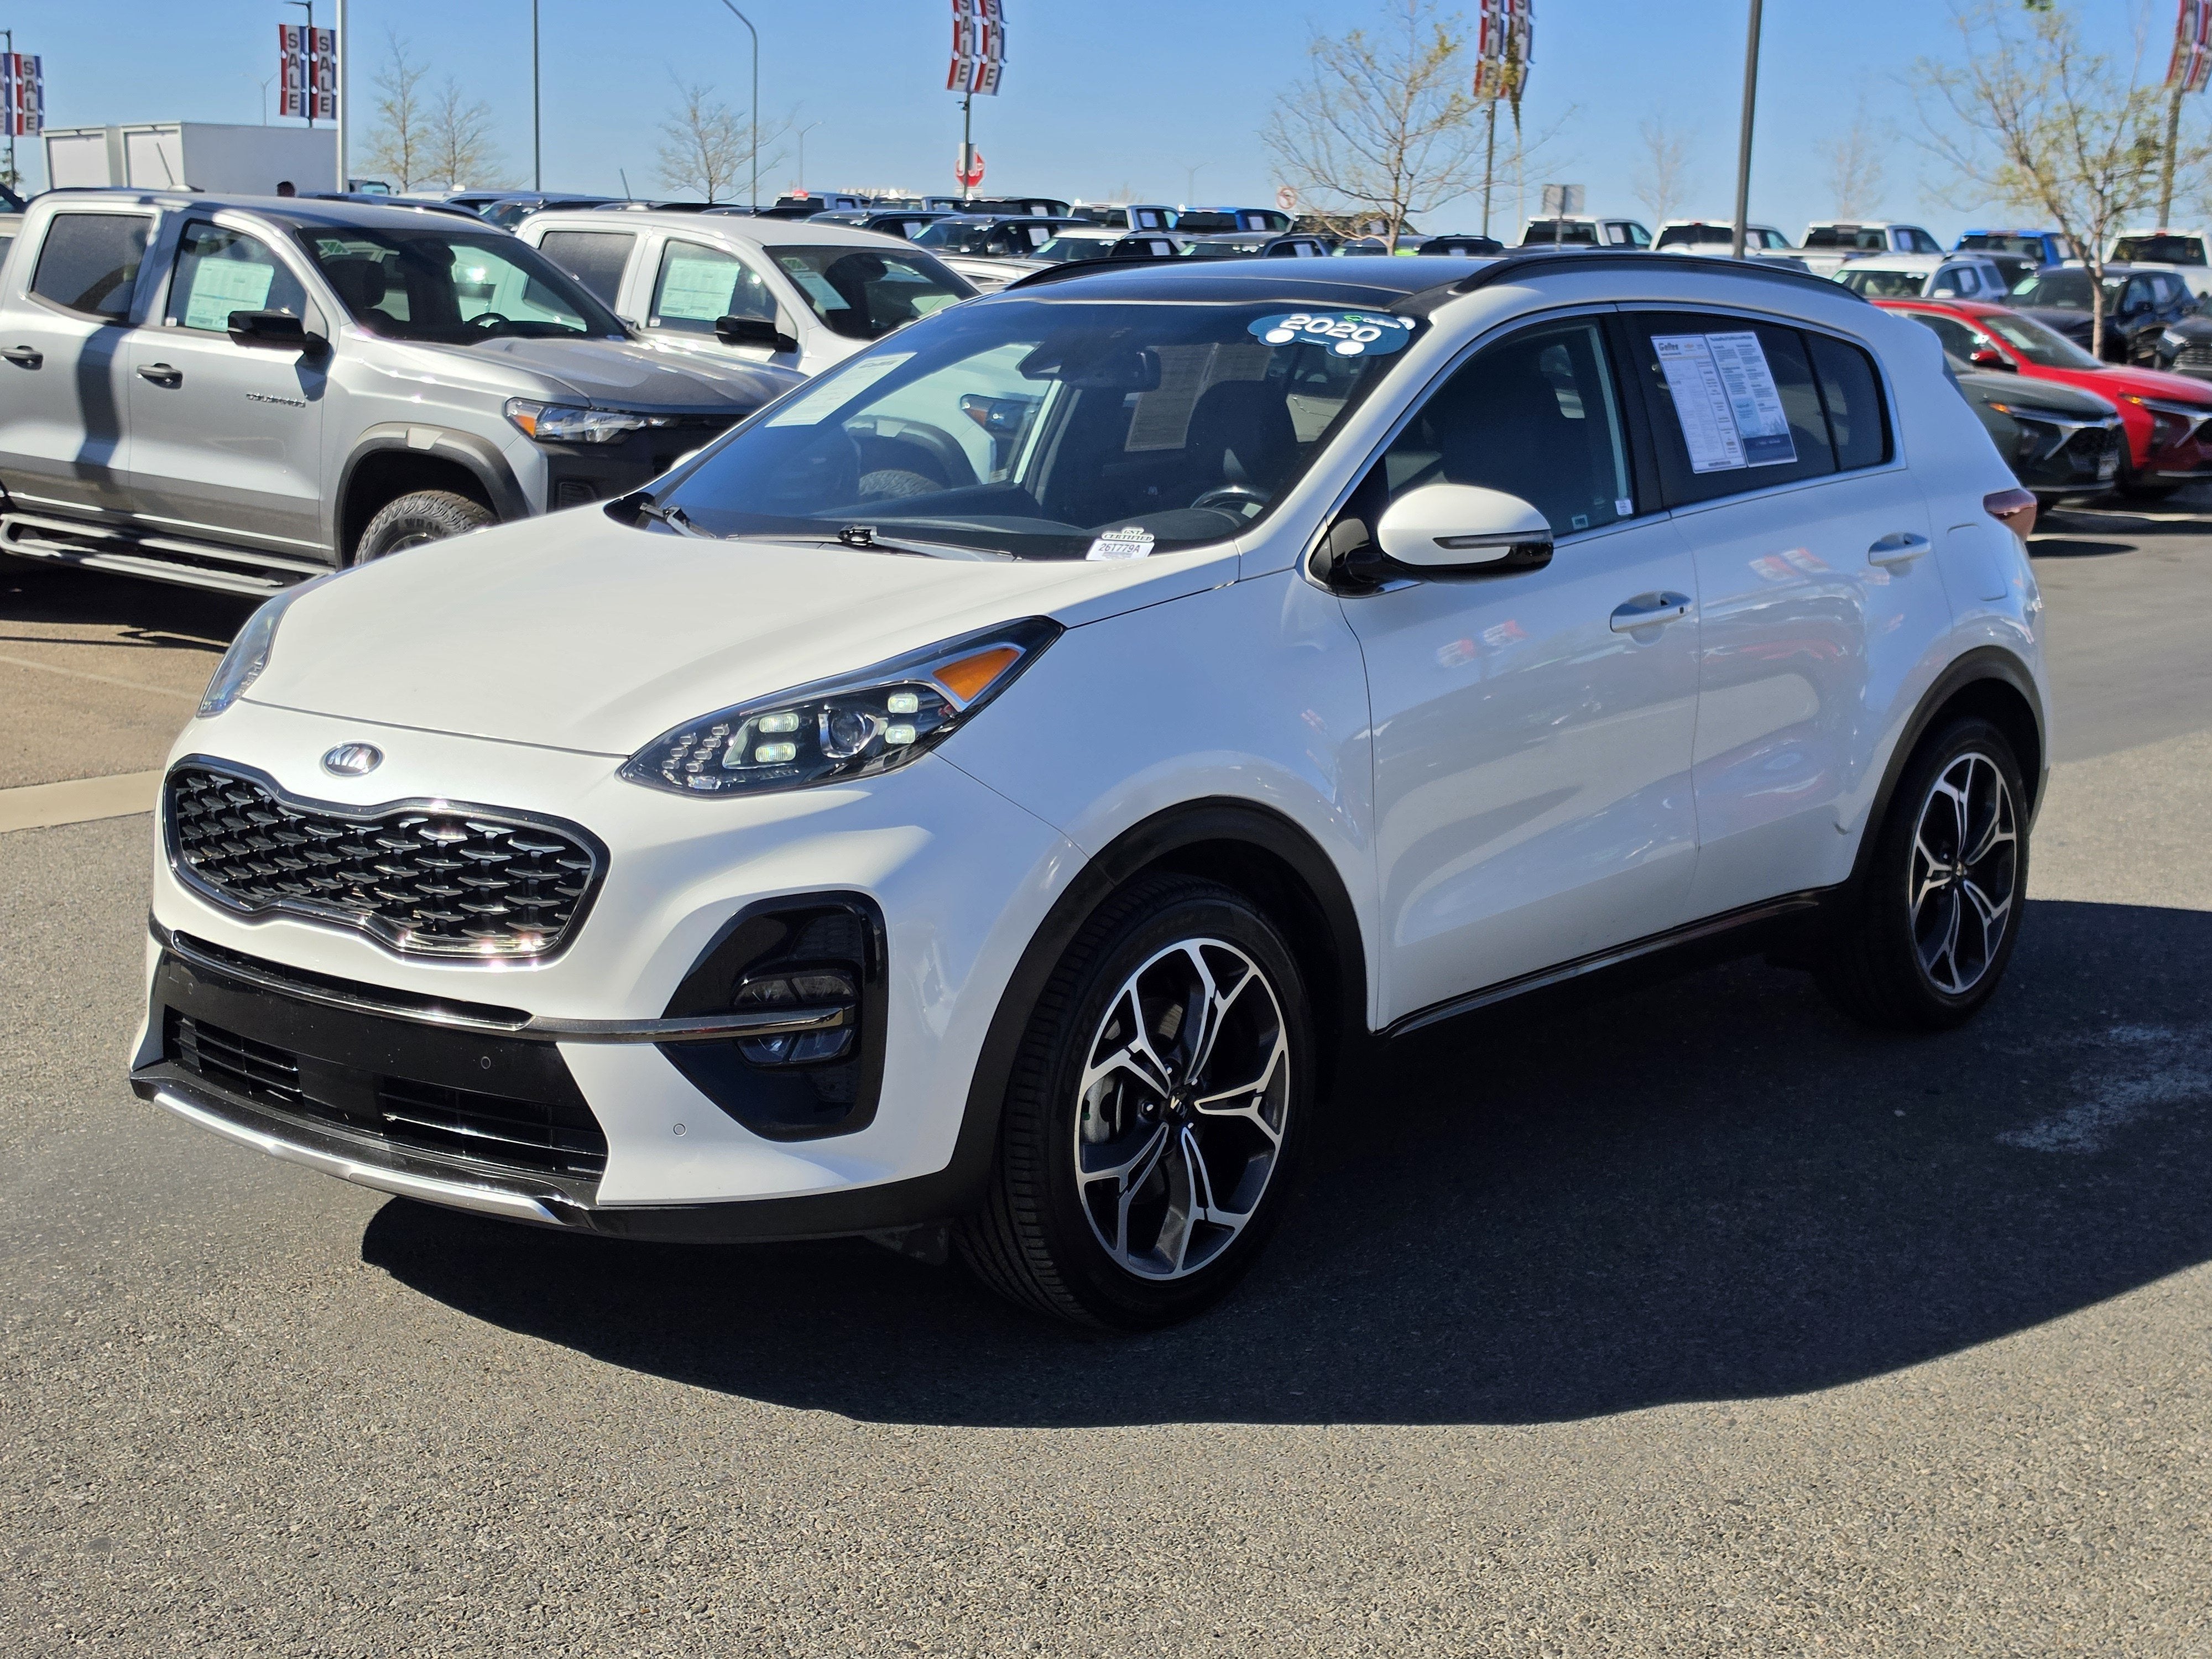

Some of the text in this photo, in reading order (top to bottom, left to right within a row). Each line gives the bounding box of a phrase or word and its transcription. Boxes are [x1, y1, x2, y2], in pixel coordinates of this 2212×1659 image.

[288, 33, 299, 109] SALE
[319, 36, 331, 112] SALE
[985, 0, 1001, 86] SALE
[24, 61, 36, 130] SALE
[1279, 313, 1382, 342] 2020
[1098, 543, 1141, 553] 26T779A
[328, 746, 372, 770] KIA
